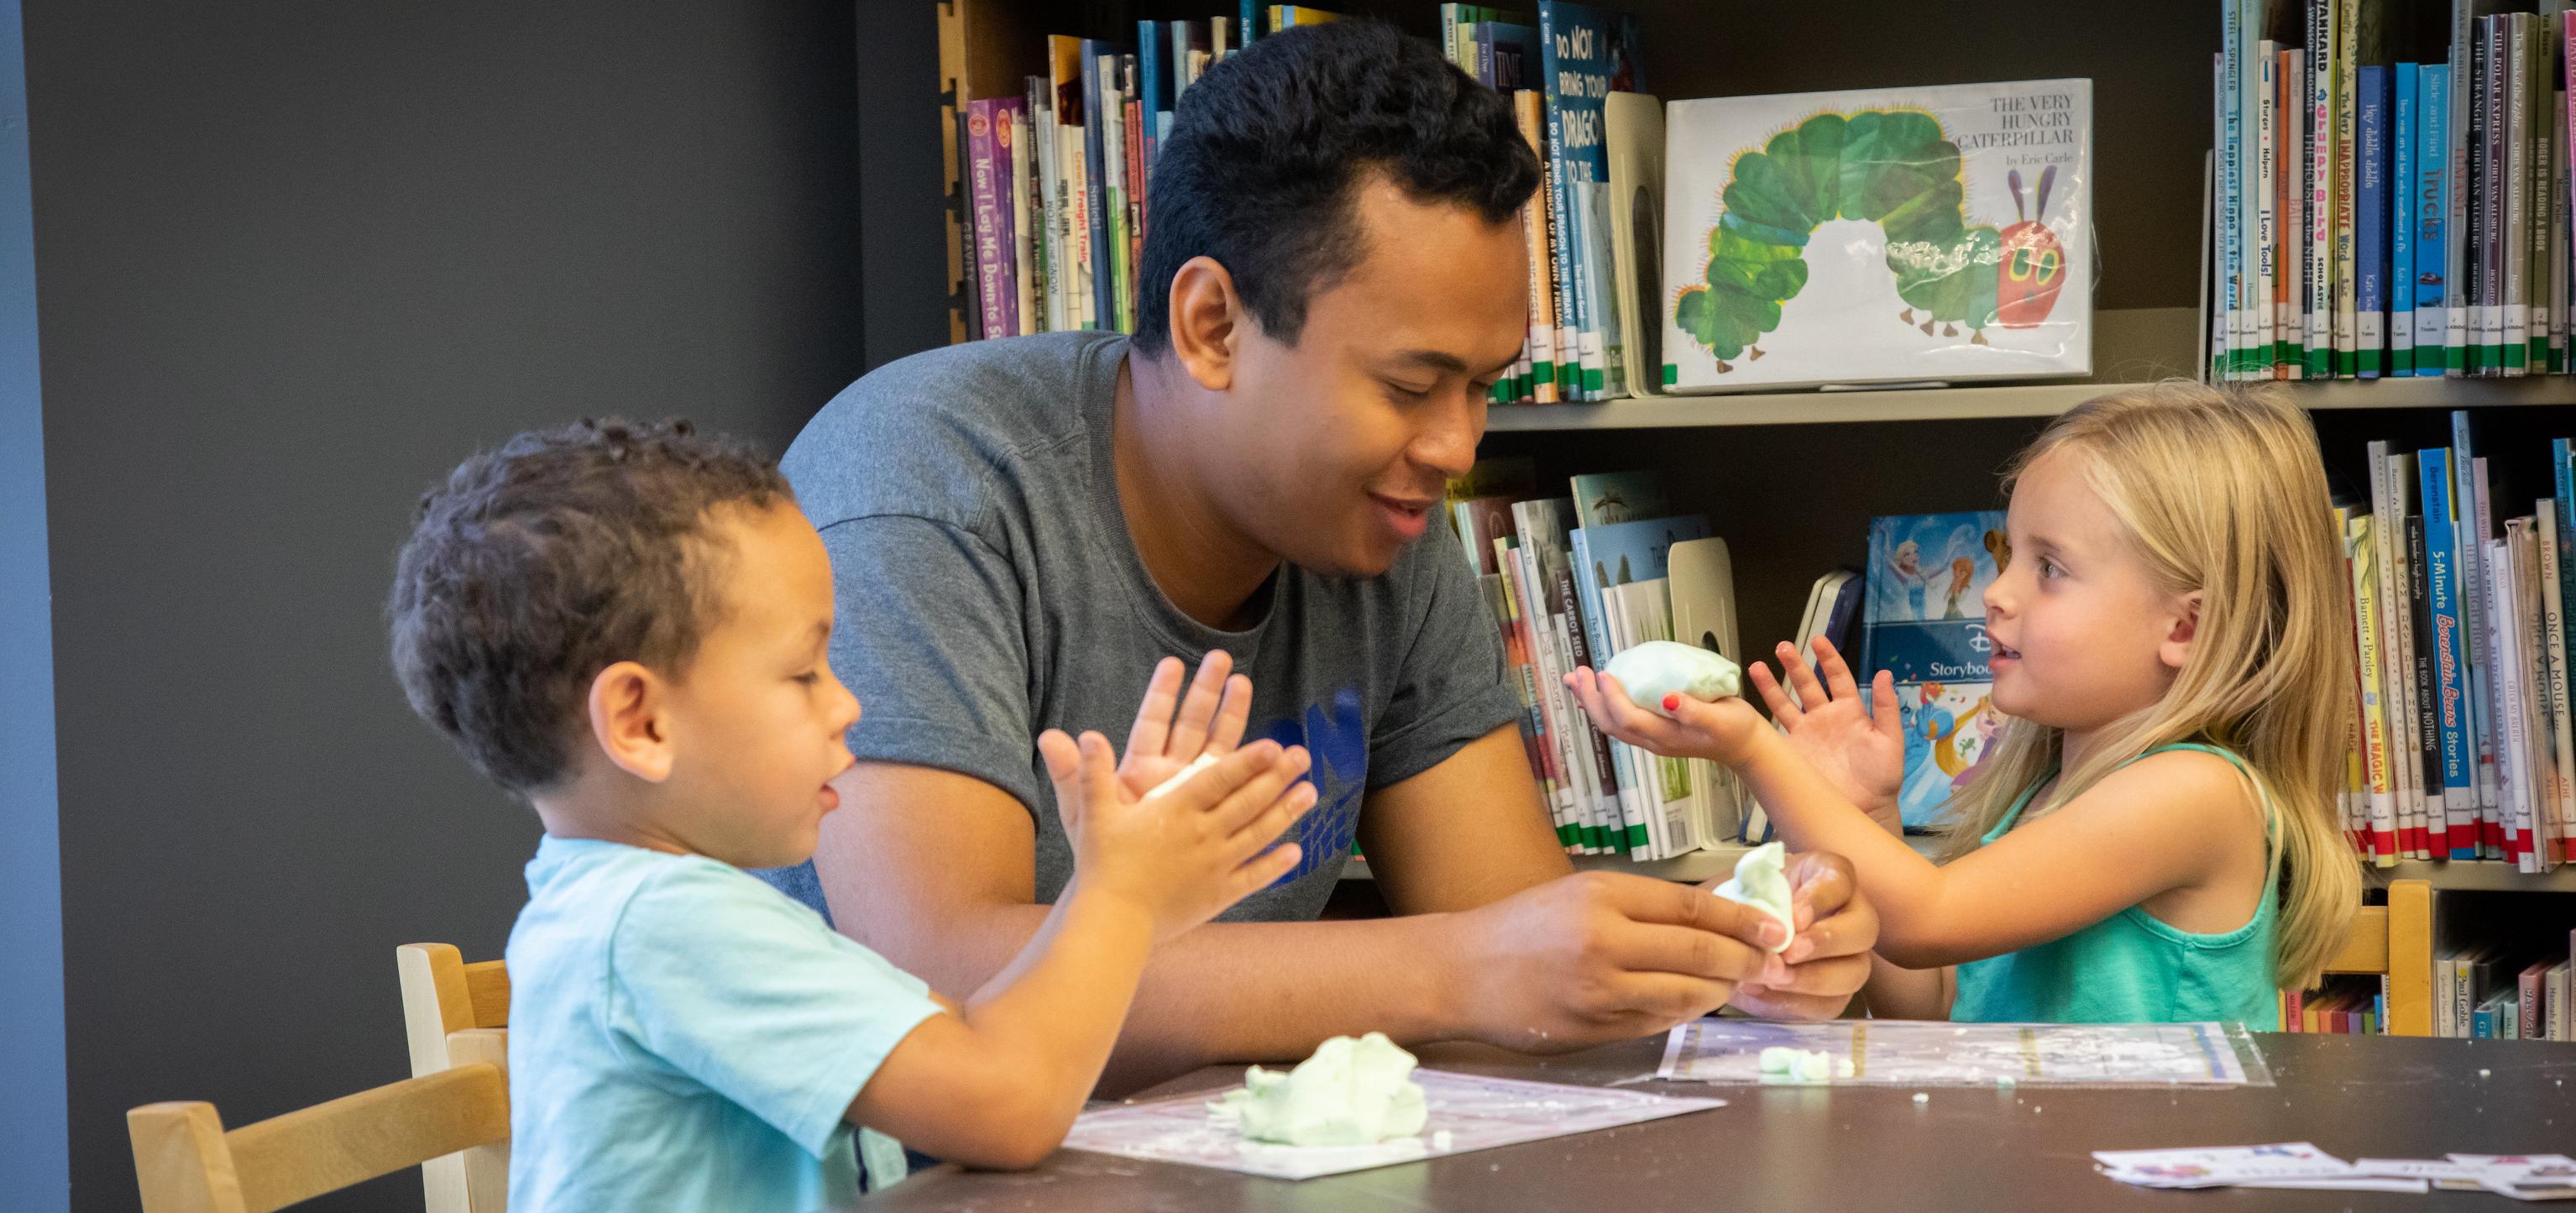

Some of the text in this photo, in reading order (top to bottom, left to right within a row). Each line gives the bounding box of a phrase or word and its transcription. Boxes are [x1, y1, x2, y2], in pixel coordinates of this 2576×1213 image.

[2317, 0, 2328, 71] TANKARD
[2458, 9, 2466, 33] VAN
[2542, 13, 2551, 29] Van
[1556, 25, 1593, 60] DO NOT
[2228, 11, 2236, 91] STEEL SPENGLER
[2474, 39, 2484, 63] THE
[2494, 30, 2503, 53] THE
[2515, 32, 2524, 50] The
[2457, 35, 2466, 87] ALLSBURG
[2493, 58, 2503, 94] POLAR
[2514, 50, 2523, 77] Wreck
[1559, 71, 1606, 98] BRING YOUR
[2474, 69, 2483, 131] STRANGER
[2514, 86, 2522, 100] the
[1991, 93, 2074, 112] THE VERY
[2002, 111, 2074, 129] HUNGRY
[2400, 99, 2408, 117] There
[2430, 106, 2439, 128] and
[2511, 101, 2521, 128] Zephyr
[1956, 128, 2074, 149] CATERPILLAR
[2492, 98, 2501, 146] EXPRESS
[2006, 152, 2074, 165] by Eric Carle
[2306, 134, 2314, 159] THE
[2399, 137, 2406, 149] an
[2429, 130, 2439, 156] Find
[2473, 144, 2481, 172] CHRIS
[2538, 137, 2548, 165] ROGER
[1566, 159, 1577, 181] TO
[2305, 162, 2314, 207] HOUSE
[2339, 91, 2352, 262] The Very INAPPROPRIATE Word
[2397, 163, 2406, 177] lady
[2537, 169, 2547, 177] IS
[2261, 99, 2272, 277] Sturges Halpern Love Tools!
[2363, 104, 2380, 292] Hey diddle diddle Kate
[2423, 169, 2443, 242] Trucks
[2537, 180, 2547, 217] READING
[1075, 191, 1088, 263] Freight Train
[1544, 156, 1560, 277] A RAINBOW OF MY OWN
[1550, 122, 1573, 320] DO NOT BRING YOUR DRAGON TO THE LIBRARY
[2225, 109, 2238, 310] The Happiest Hippo in the World
[2472, 200, 2480, 248] ALLSBURG
[976, 159, 999, 320] Now Lay Me Down to
[1045, 201, 1059, 295] WOLF SNOW
[2305, 225, 2313, 242] the
[2536, 228, 2546, 252] BOOK
[1574, 264, 1583, 279] The
[2304, 246, 2313, 285] NIGHT
[2557, 462, 2567, 493] Peter
[2479, 502, 2487, 517] THE
[1560, 578, 1584, 657] THE CARROT SEED
[2467, 544, 2485, 668] HELLO LIGHTHOUSE
[2542, 540, 2560, 665] BROWN ONCE A
[1588, 616, 1604, 658] The Rough
[2430, 467, 2459, 777] Berenstain 5-Minute Berenstain Bears Stories
[2399, 571, 2419, 734] SAM DAVE DIG HOLE
[2411, 540, 2435, 750] bender hugh murphy THE BOOK ABOUT NOTHING
[2484, 558, 2506, 767] JAN BRETT HEDGIE'S SURPRISE
[1930, 661, 1992, 677] Storyboo
[2360, 597, 2384, 781] Barnett Parsley THE MAGIC
[2507, 681, 2520, 743] CATCH BREATH
[2458, 975, 2469, 1027] Paul Goble
[2549, 987, 2558, 1018] Hannah
